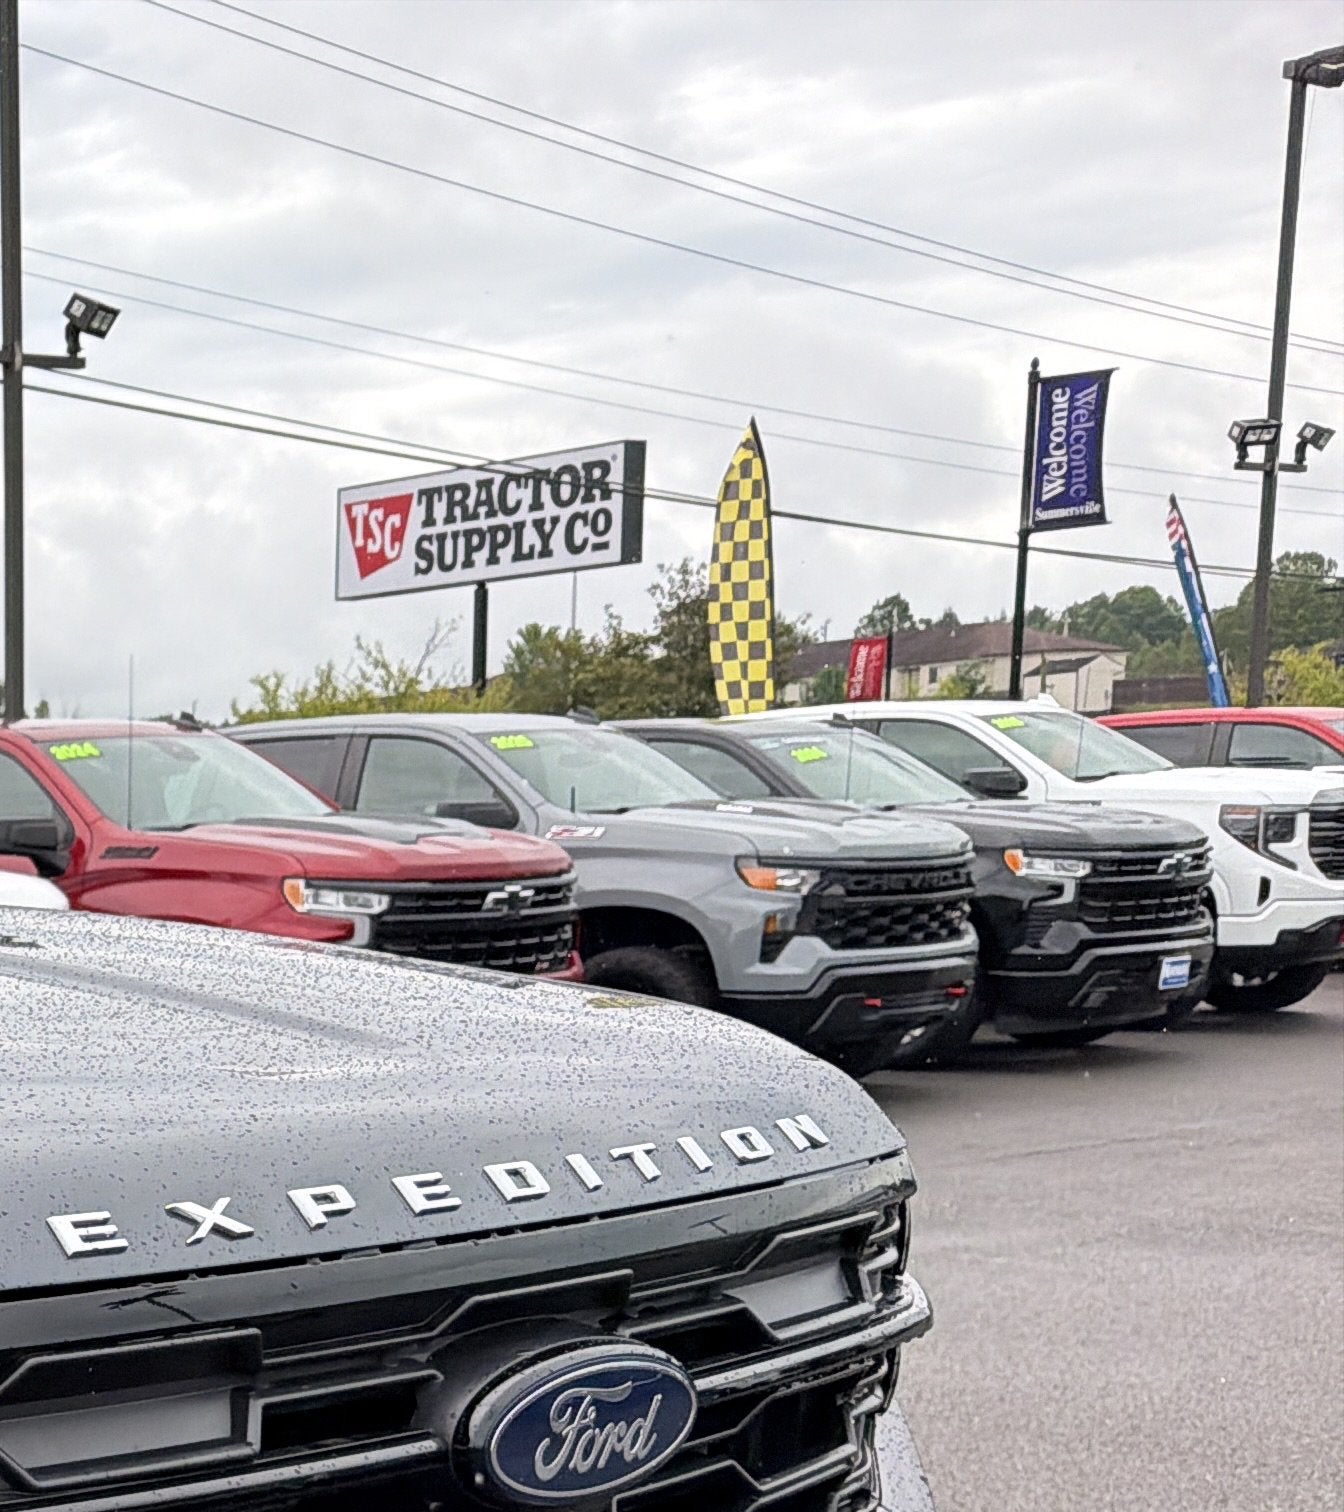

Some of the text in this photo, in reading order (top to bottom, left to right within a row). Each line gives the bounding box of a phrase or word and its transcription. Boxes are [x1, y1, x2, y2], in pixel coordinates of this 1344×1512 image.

[1042, 387, 1071, 502] Welcome
[1069, 383, 1099, 498] Welcome
[349, 503, 402, 560] TSC
[416, 459, 613, 529] TRACTOR
[1034, 501, 1102, 521] Summersville
[414, 516, 561, 577] SUPPLY
[45, 1113, 832, 1259] EXPEDITION
[533, 1380, 663, 1483] Ford
